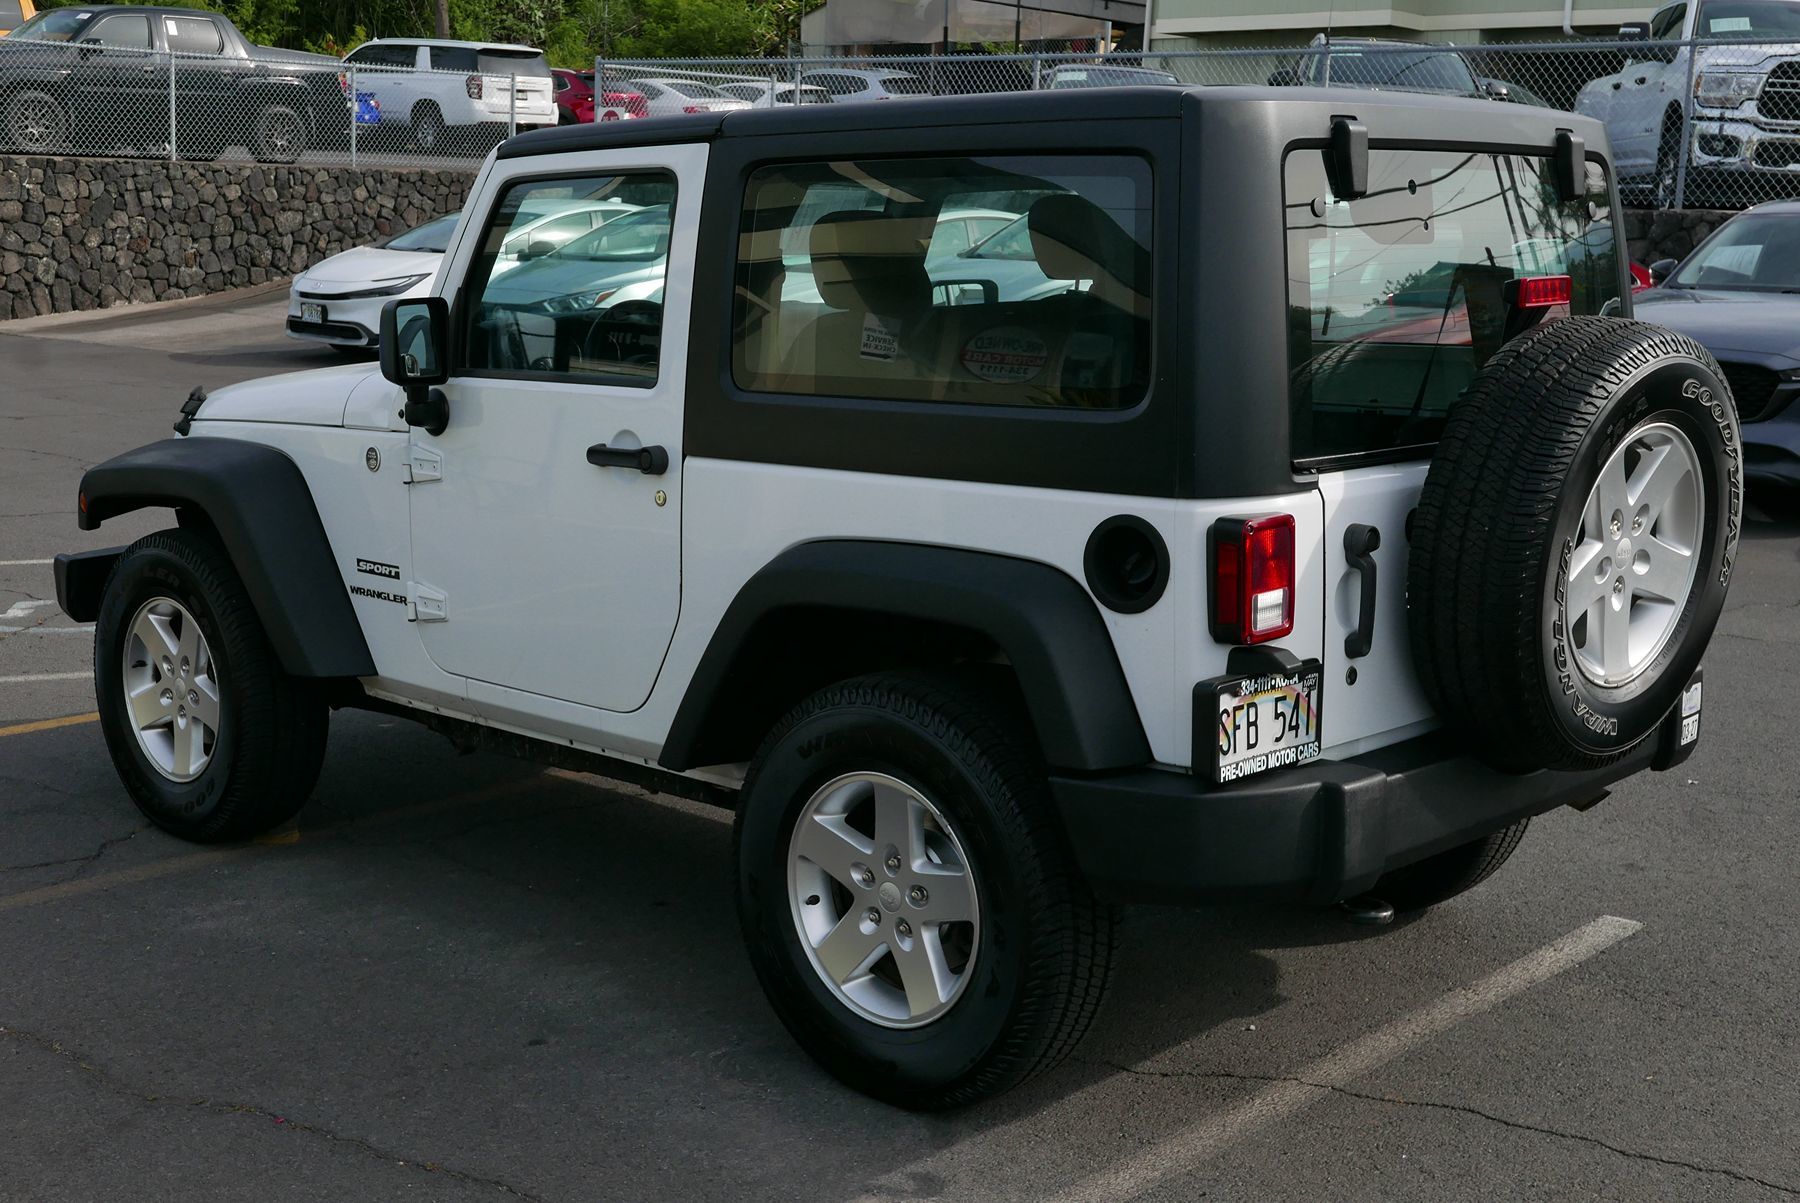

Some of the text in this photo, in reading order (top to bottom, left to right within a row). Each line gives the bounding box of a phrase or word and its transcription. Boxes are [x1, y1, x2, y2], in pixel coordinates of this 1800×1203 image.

[1682, 378, 1740, 588] GOODYEAR
[350, 585, 407, 606] WRANGLER
[358, 560, 399, 577] SPORT
[1553, 536, 1618, 736] WRANGLER
[1219, 690, 1312, 756] SFB 541
[1220, 741, 1319, 783] PRE-OWNED MOTOR CARS
